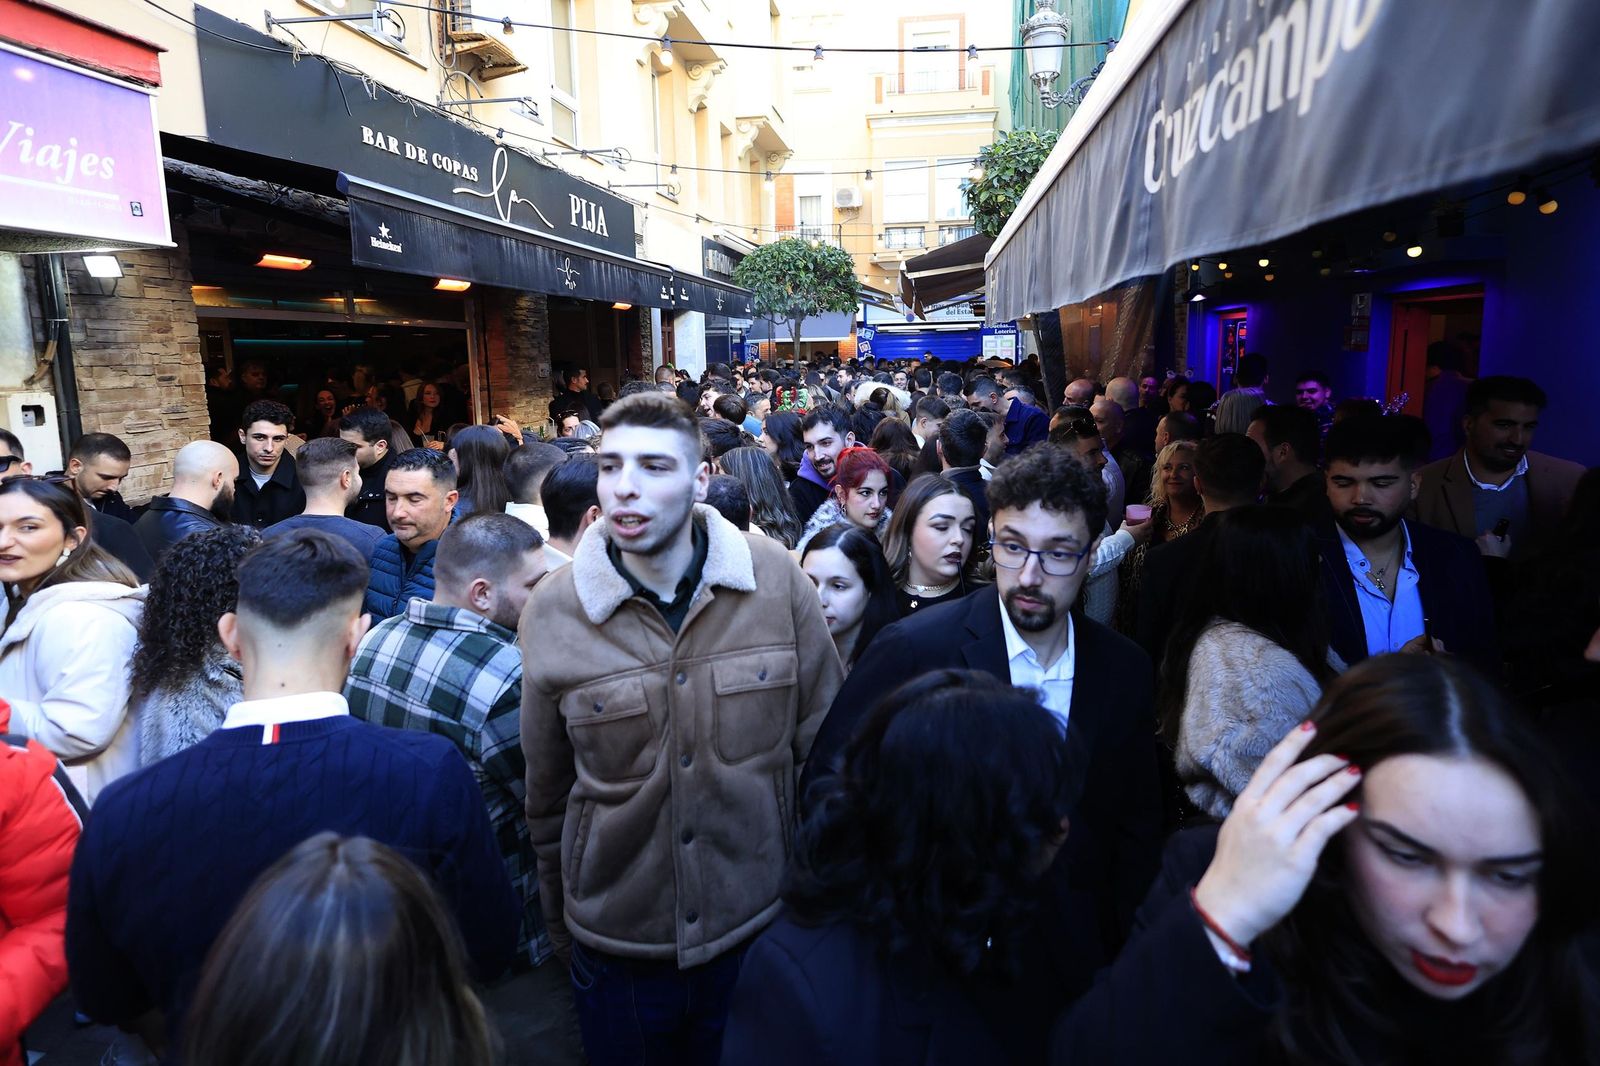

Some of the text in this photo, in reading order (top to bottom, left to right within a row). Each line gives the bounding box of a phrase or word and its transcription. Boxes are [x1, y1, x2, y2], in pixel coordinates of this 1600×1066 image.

[361, 125, 479, 182] BAR DE COPAS
[568, 193, 609, 237] PIJA
[370, 236, 403, 253] Heineken
